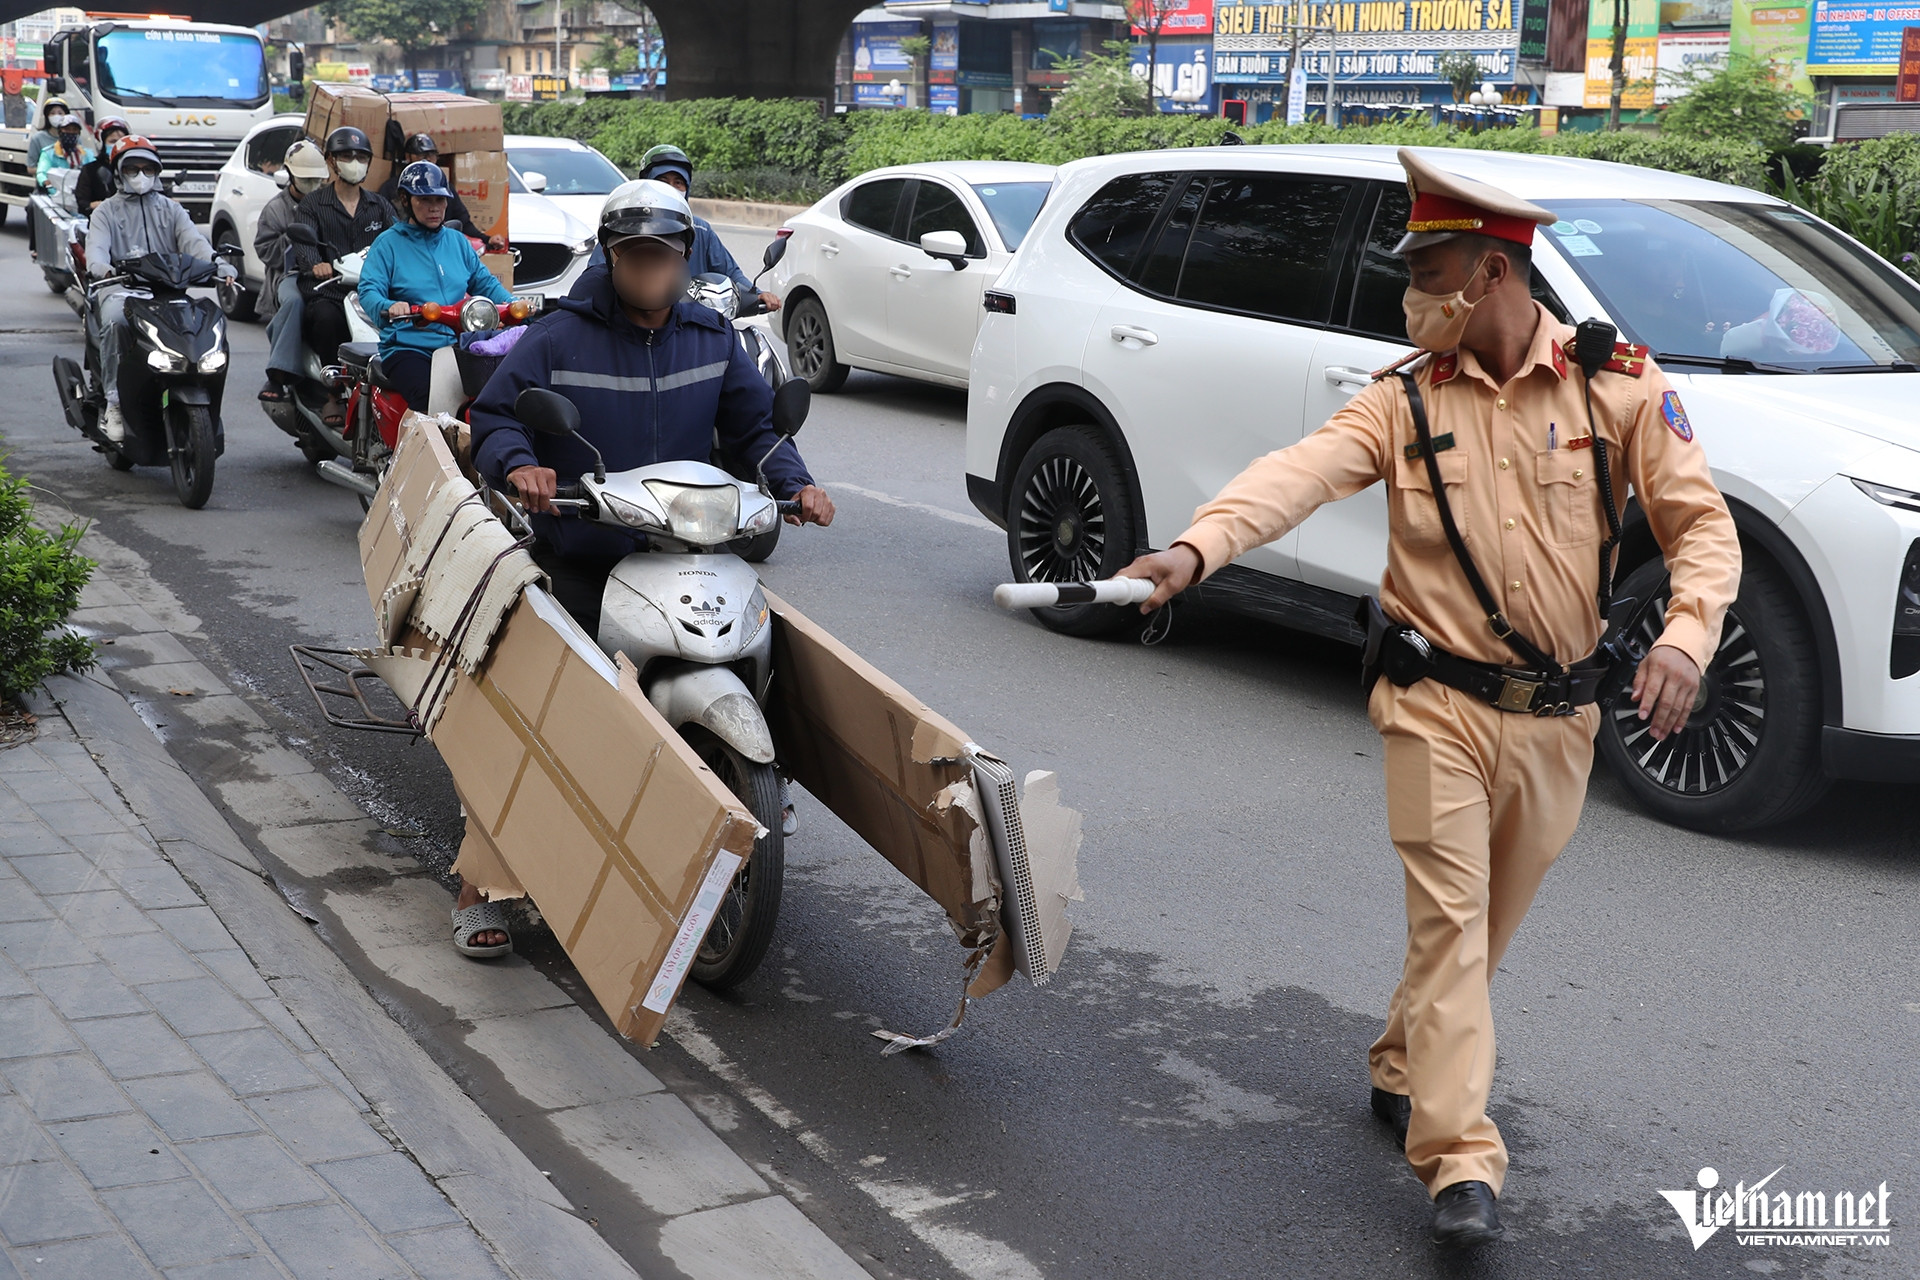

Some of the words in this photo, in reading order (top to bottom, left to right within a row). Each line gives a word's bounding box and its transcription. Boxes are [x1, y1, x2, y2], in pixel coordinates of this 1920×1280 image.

[1218, 1, 1254, 34] SIÊU
[1486, 0, 1512, 31] SA
[1815, 11, 1828, 22] IN
[1829, 9, 1867, 22] NHANH
[1873, 9, 1886, 20] IN
[1320, 56, 1340, 74] HI
[1370, 54, 1397, 74] TƯƠI
[1401, 49, 1434, 74] SỐNG
[1588, 56, 1613, 84] NGỌ
[1370, 91, 1403, 103] MANG
[168, 114, 217, 126] JAC
[693, 618, 724, 626] adidas
